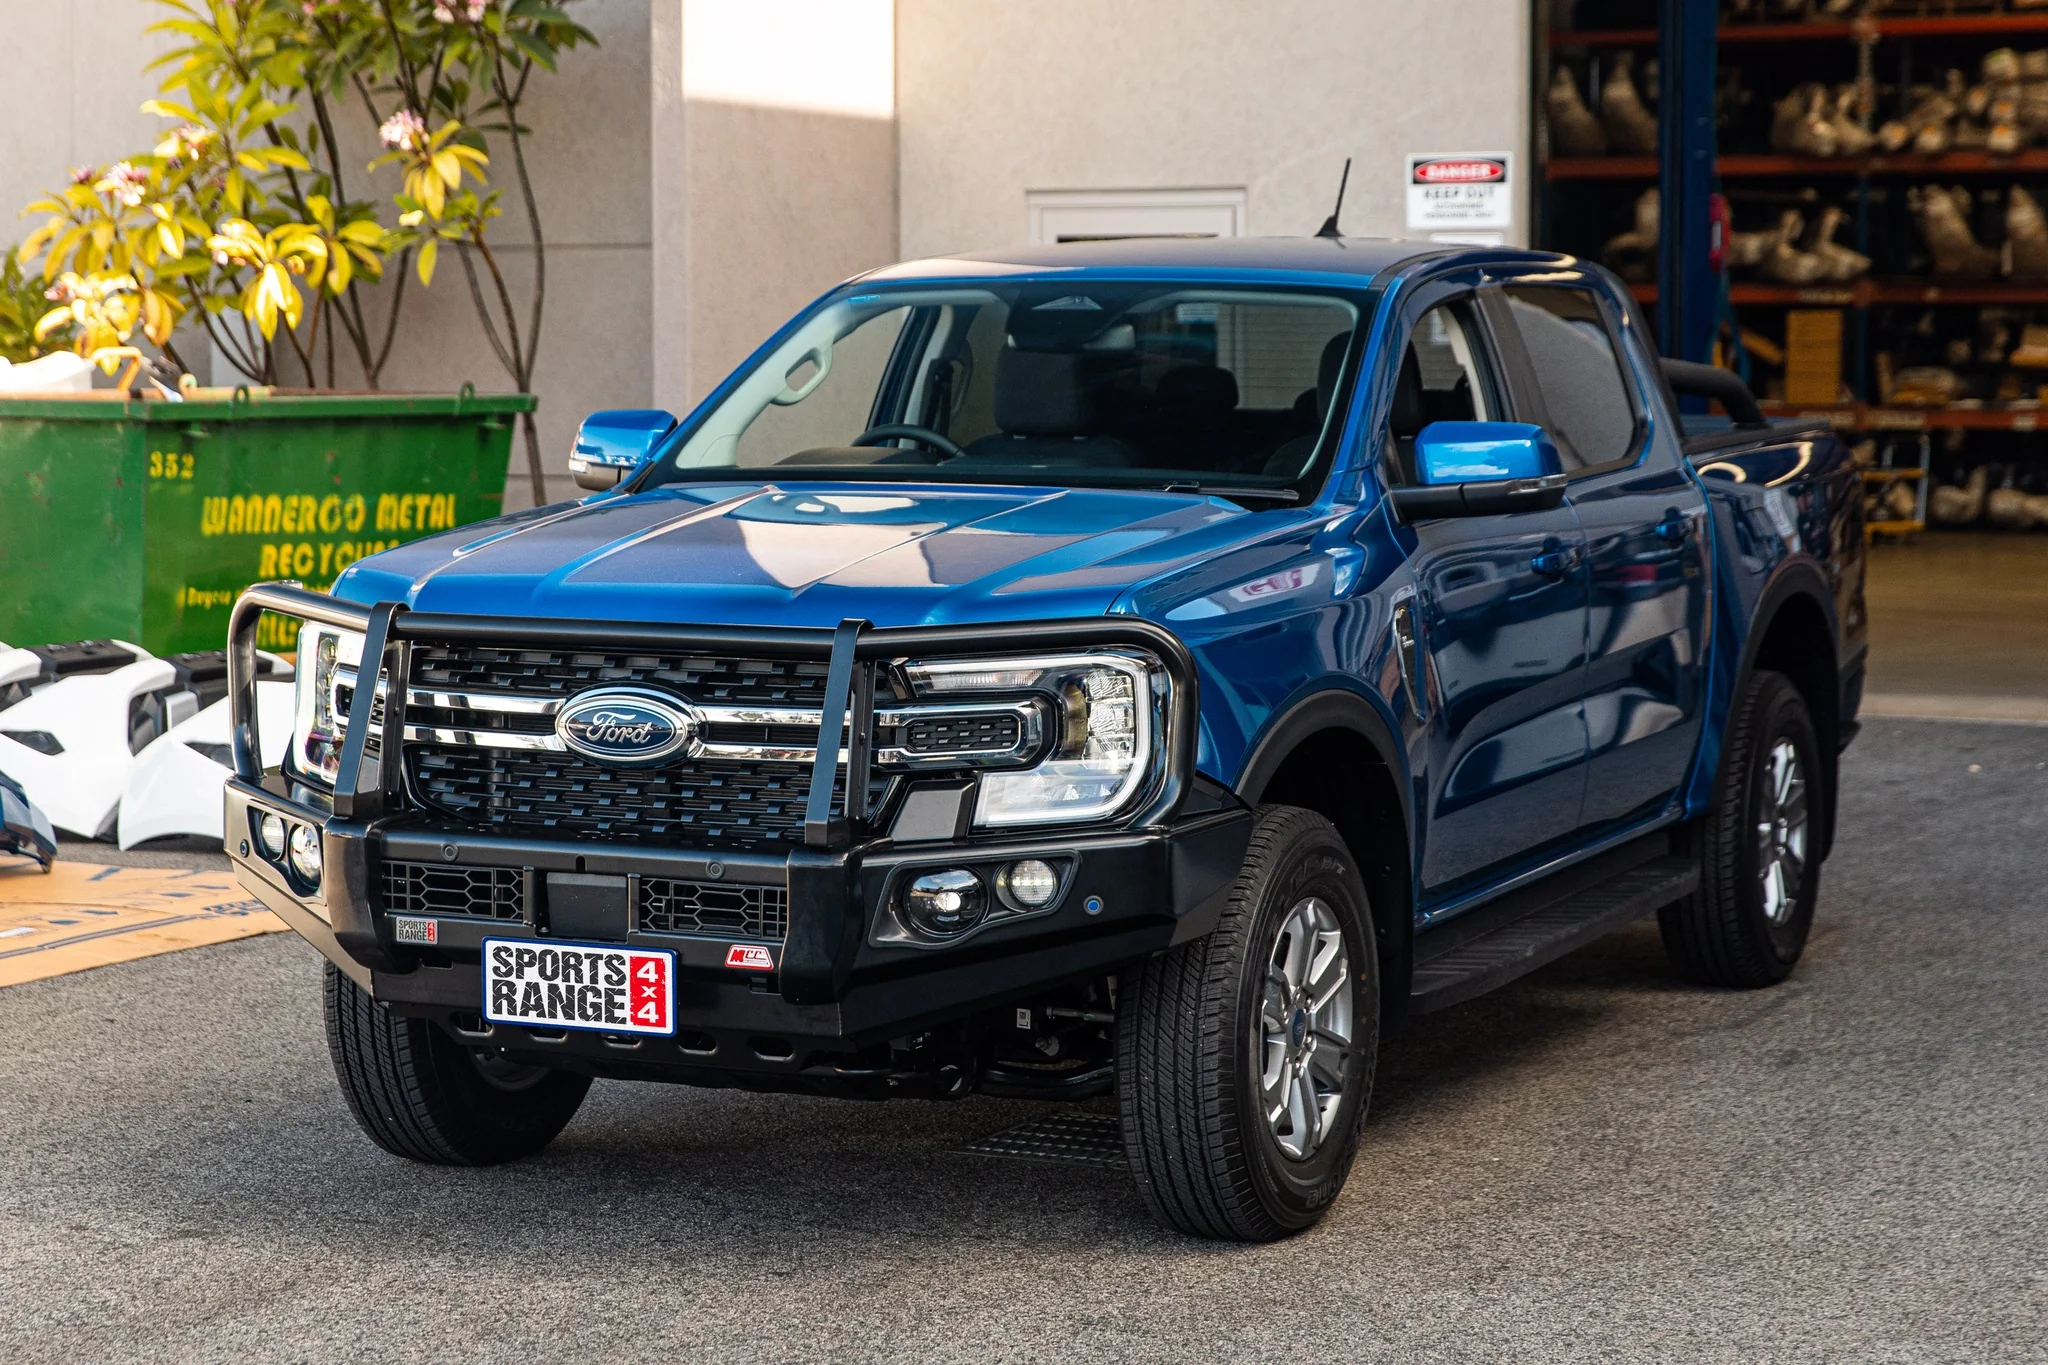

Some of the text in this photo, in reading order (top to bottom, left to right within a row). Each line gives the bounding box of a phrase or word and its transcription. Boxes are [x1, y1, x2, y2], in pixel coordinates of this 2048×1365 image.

[1426, 164, 1492, 179] DANGER
[1423, 185, 1496, 199] KEEP OUT
[149, 450, 195, 480] 352
[376, 492, 456, 531] METAL
[259, 539, 400, 578] RECYC
[586, 711, 653, 745] Ford
[398, 919, 428, 931] SPORTS
[398, 929, 428, 942] RANGE
[492, 945, 627, 987] SPORTS
[729, 948, 767, 962] MCC
[492, 978, 627, 1025] RANGE
